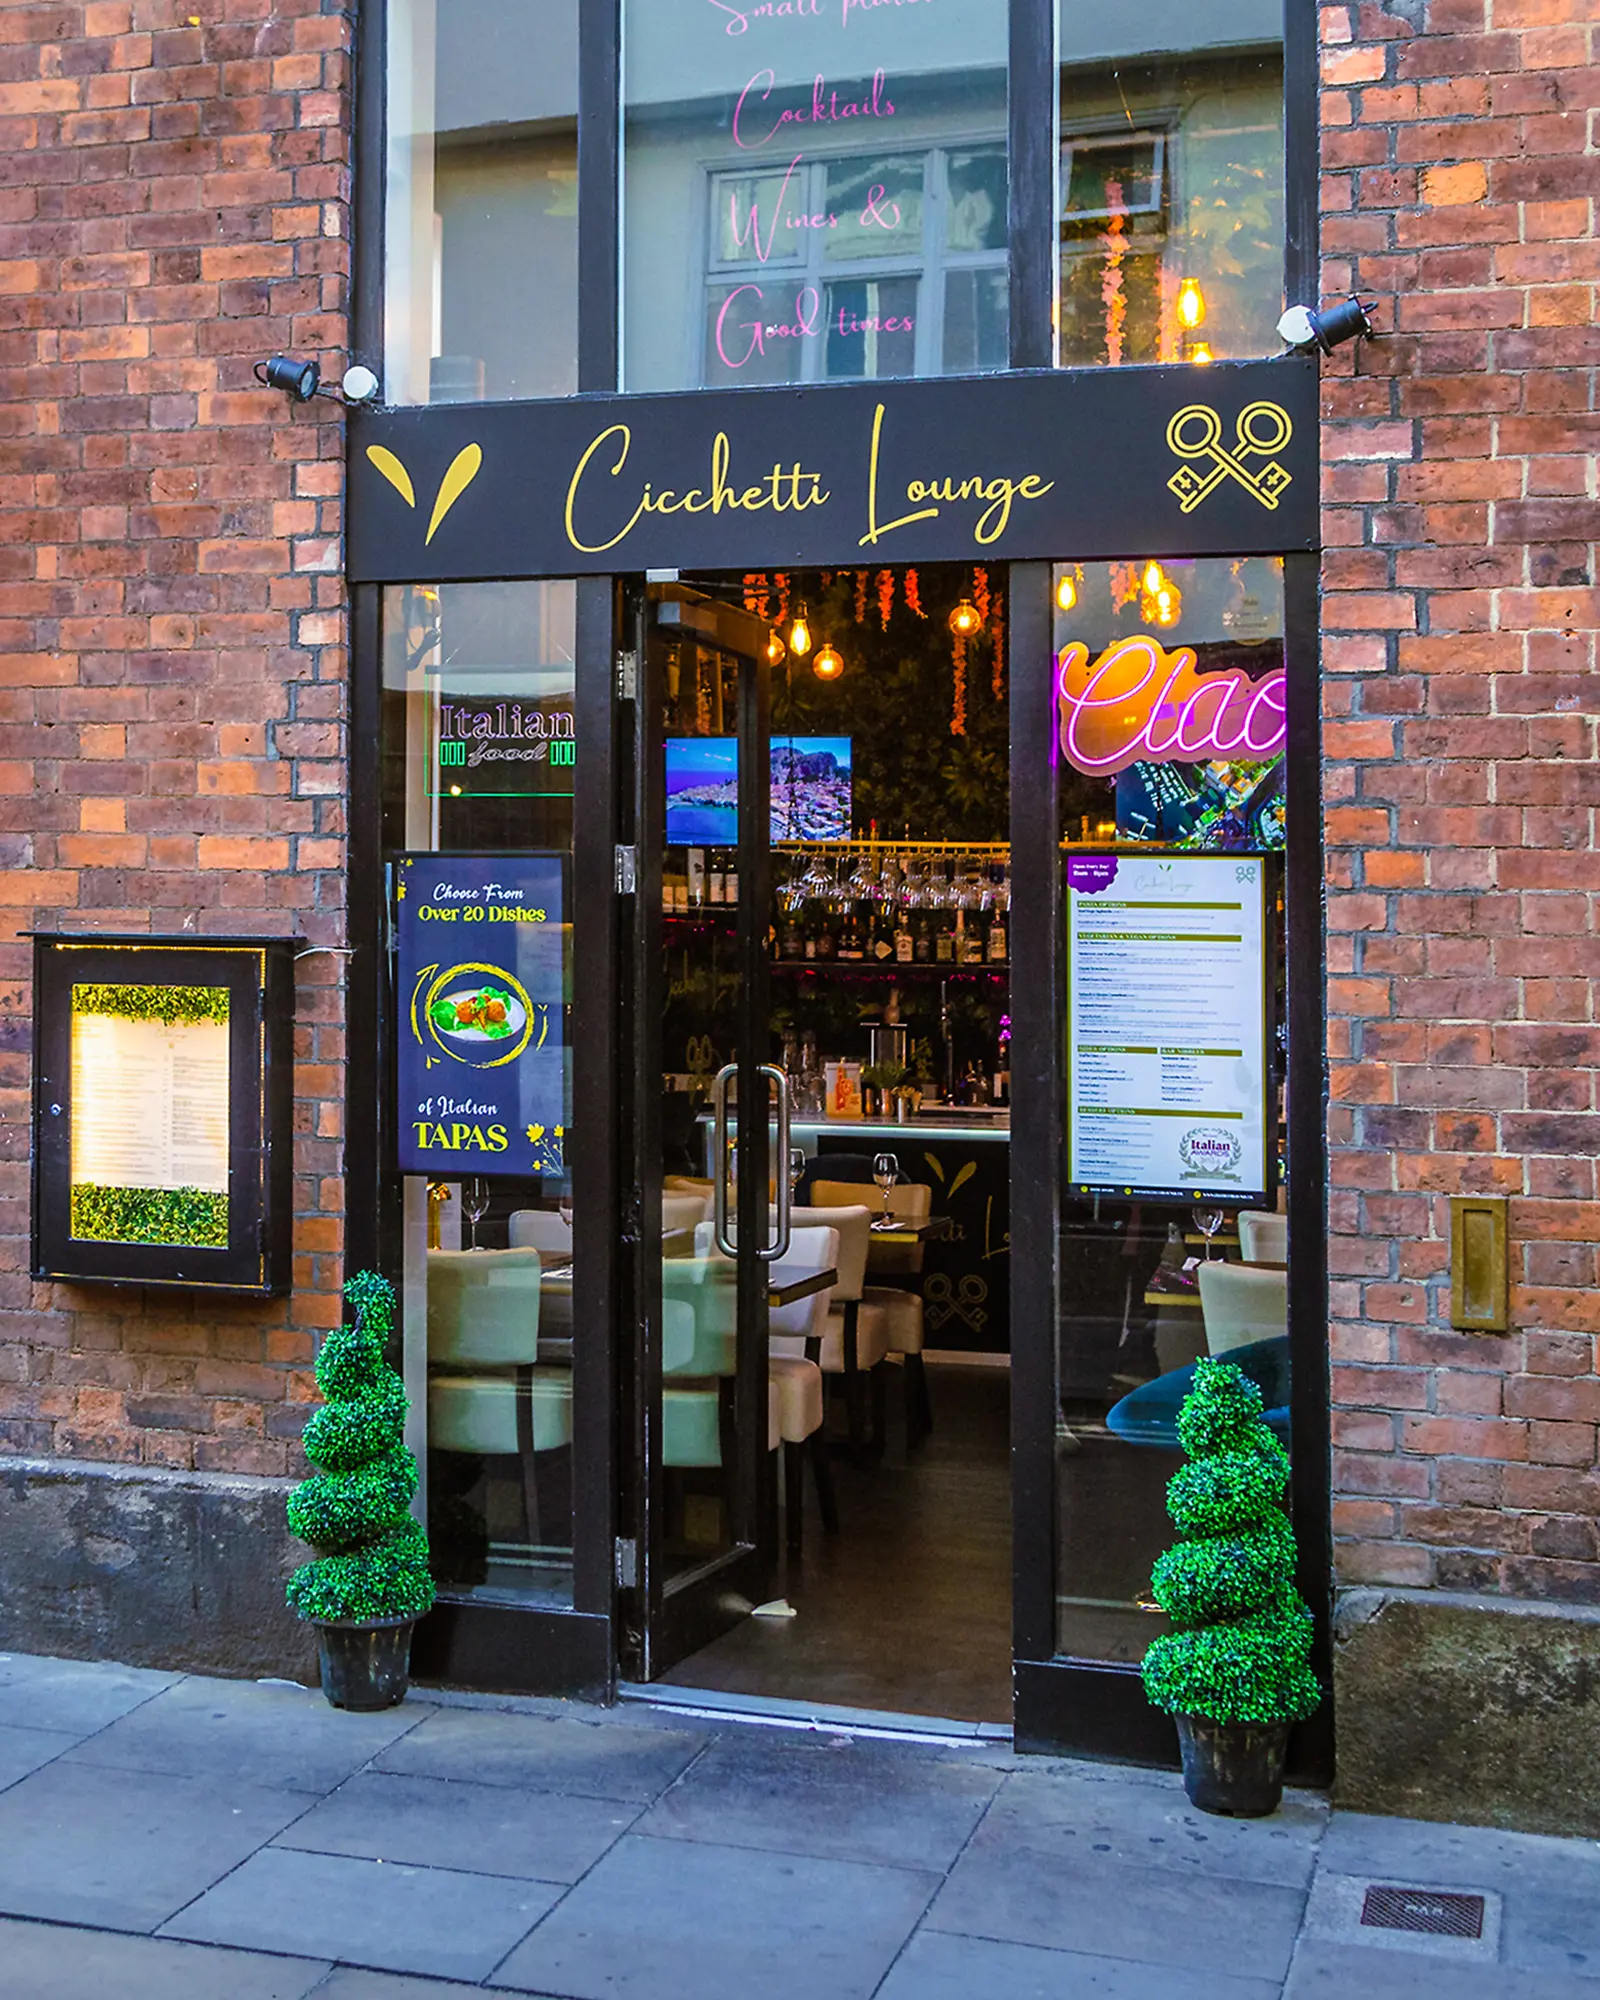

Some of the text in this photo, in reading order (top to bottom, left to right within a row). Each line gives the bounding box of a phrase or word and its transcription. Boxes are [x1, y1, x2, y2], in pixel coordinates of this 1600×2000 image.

[733, 67, 896, 150] Cocktails
[731, 154, 901, 263] Wines &
[716, 284, 916, 368] Good times
[565, 403, 1054, 553] Cicchetti Lounge
[439, 703, 576, 739] Italian
[1059, 642, 1286, 767] Ciao
[467, 740, 549, 768] food
[433, 882, 525, 902] Choose From
[418, 904, 547, 922] Over 20 Dishes
[418, 1095, 498, 1117] of Italian
[412, 1121, 509, 1152] TAPAS
[1191, 1139, 1231, 1151] Italian
